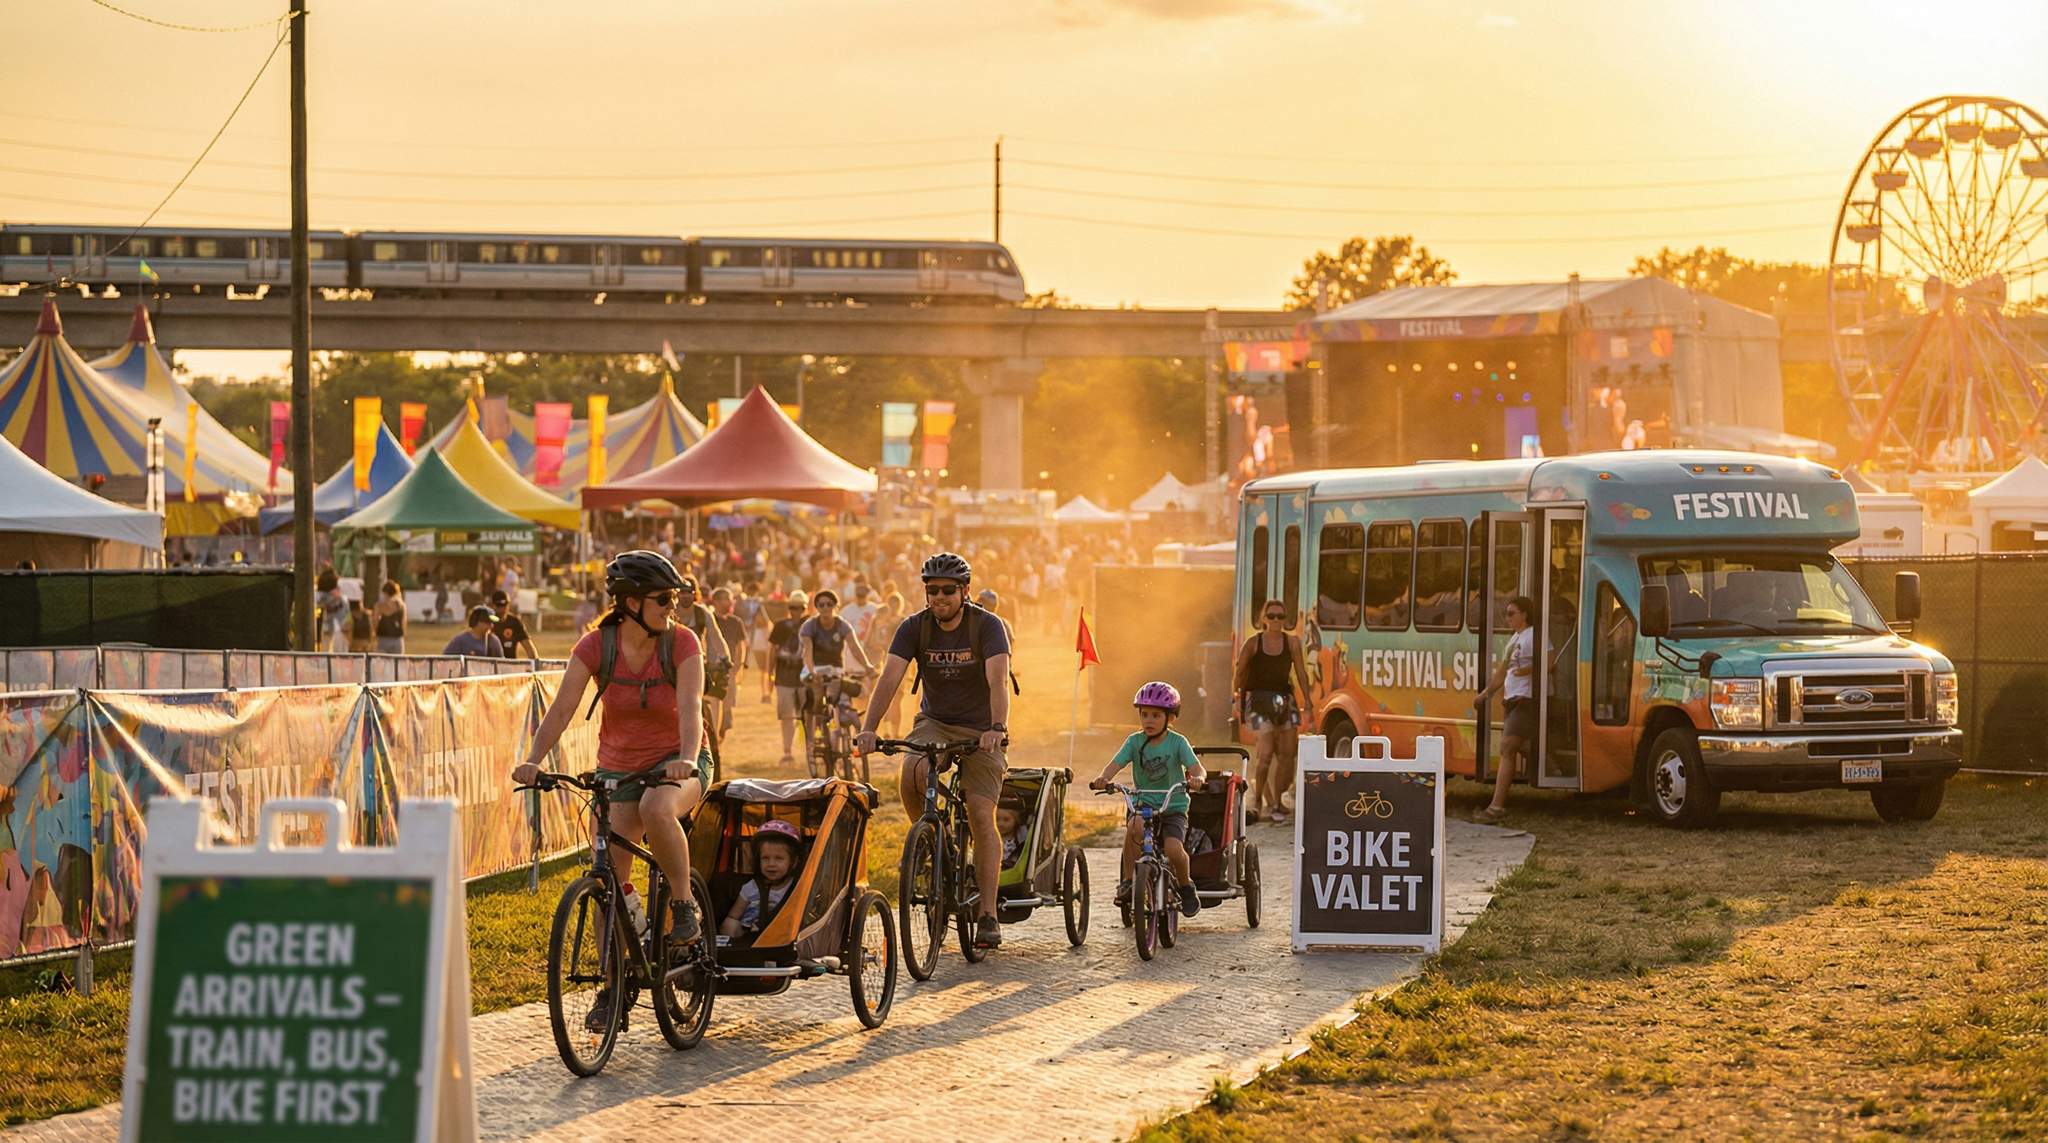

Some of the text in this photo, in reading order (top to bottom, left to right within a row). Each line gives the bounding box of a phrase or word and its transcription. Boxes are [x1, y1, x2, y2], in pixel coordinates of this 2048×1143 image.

[1672, 491, 1809, 521] FESTIVAL
[1362, 649, 1447, 689] FESTIVAL
[1326, 830, 1410, 868] BIKE
[1311, 873, 1423, 912] VALET
[226, 923, 355, 966] GREEN
[173, 974, 366, 1018] ARRIVALS
[168, 1026, 399, 1077] TRAIN, BUS,
[173, 1079, 385, 1124] BIKE FIRST
